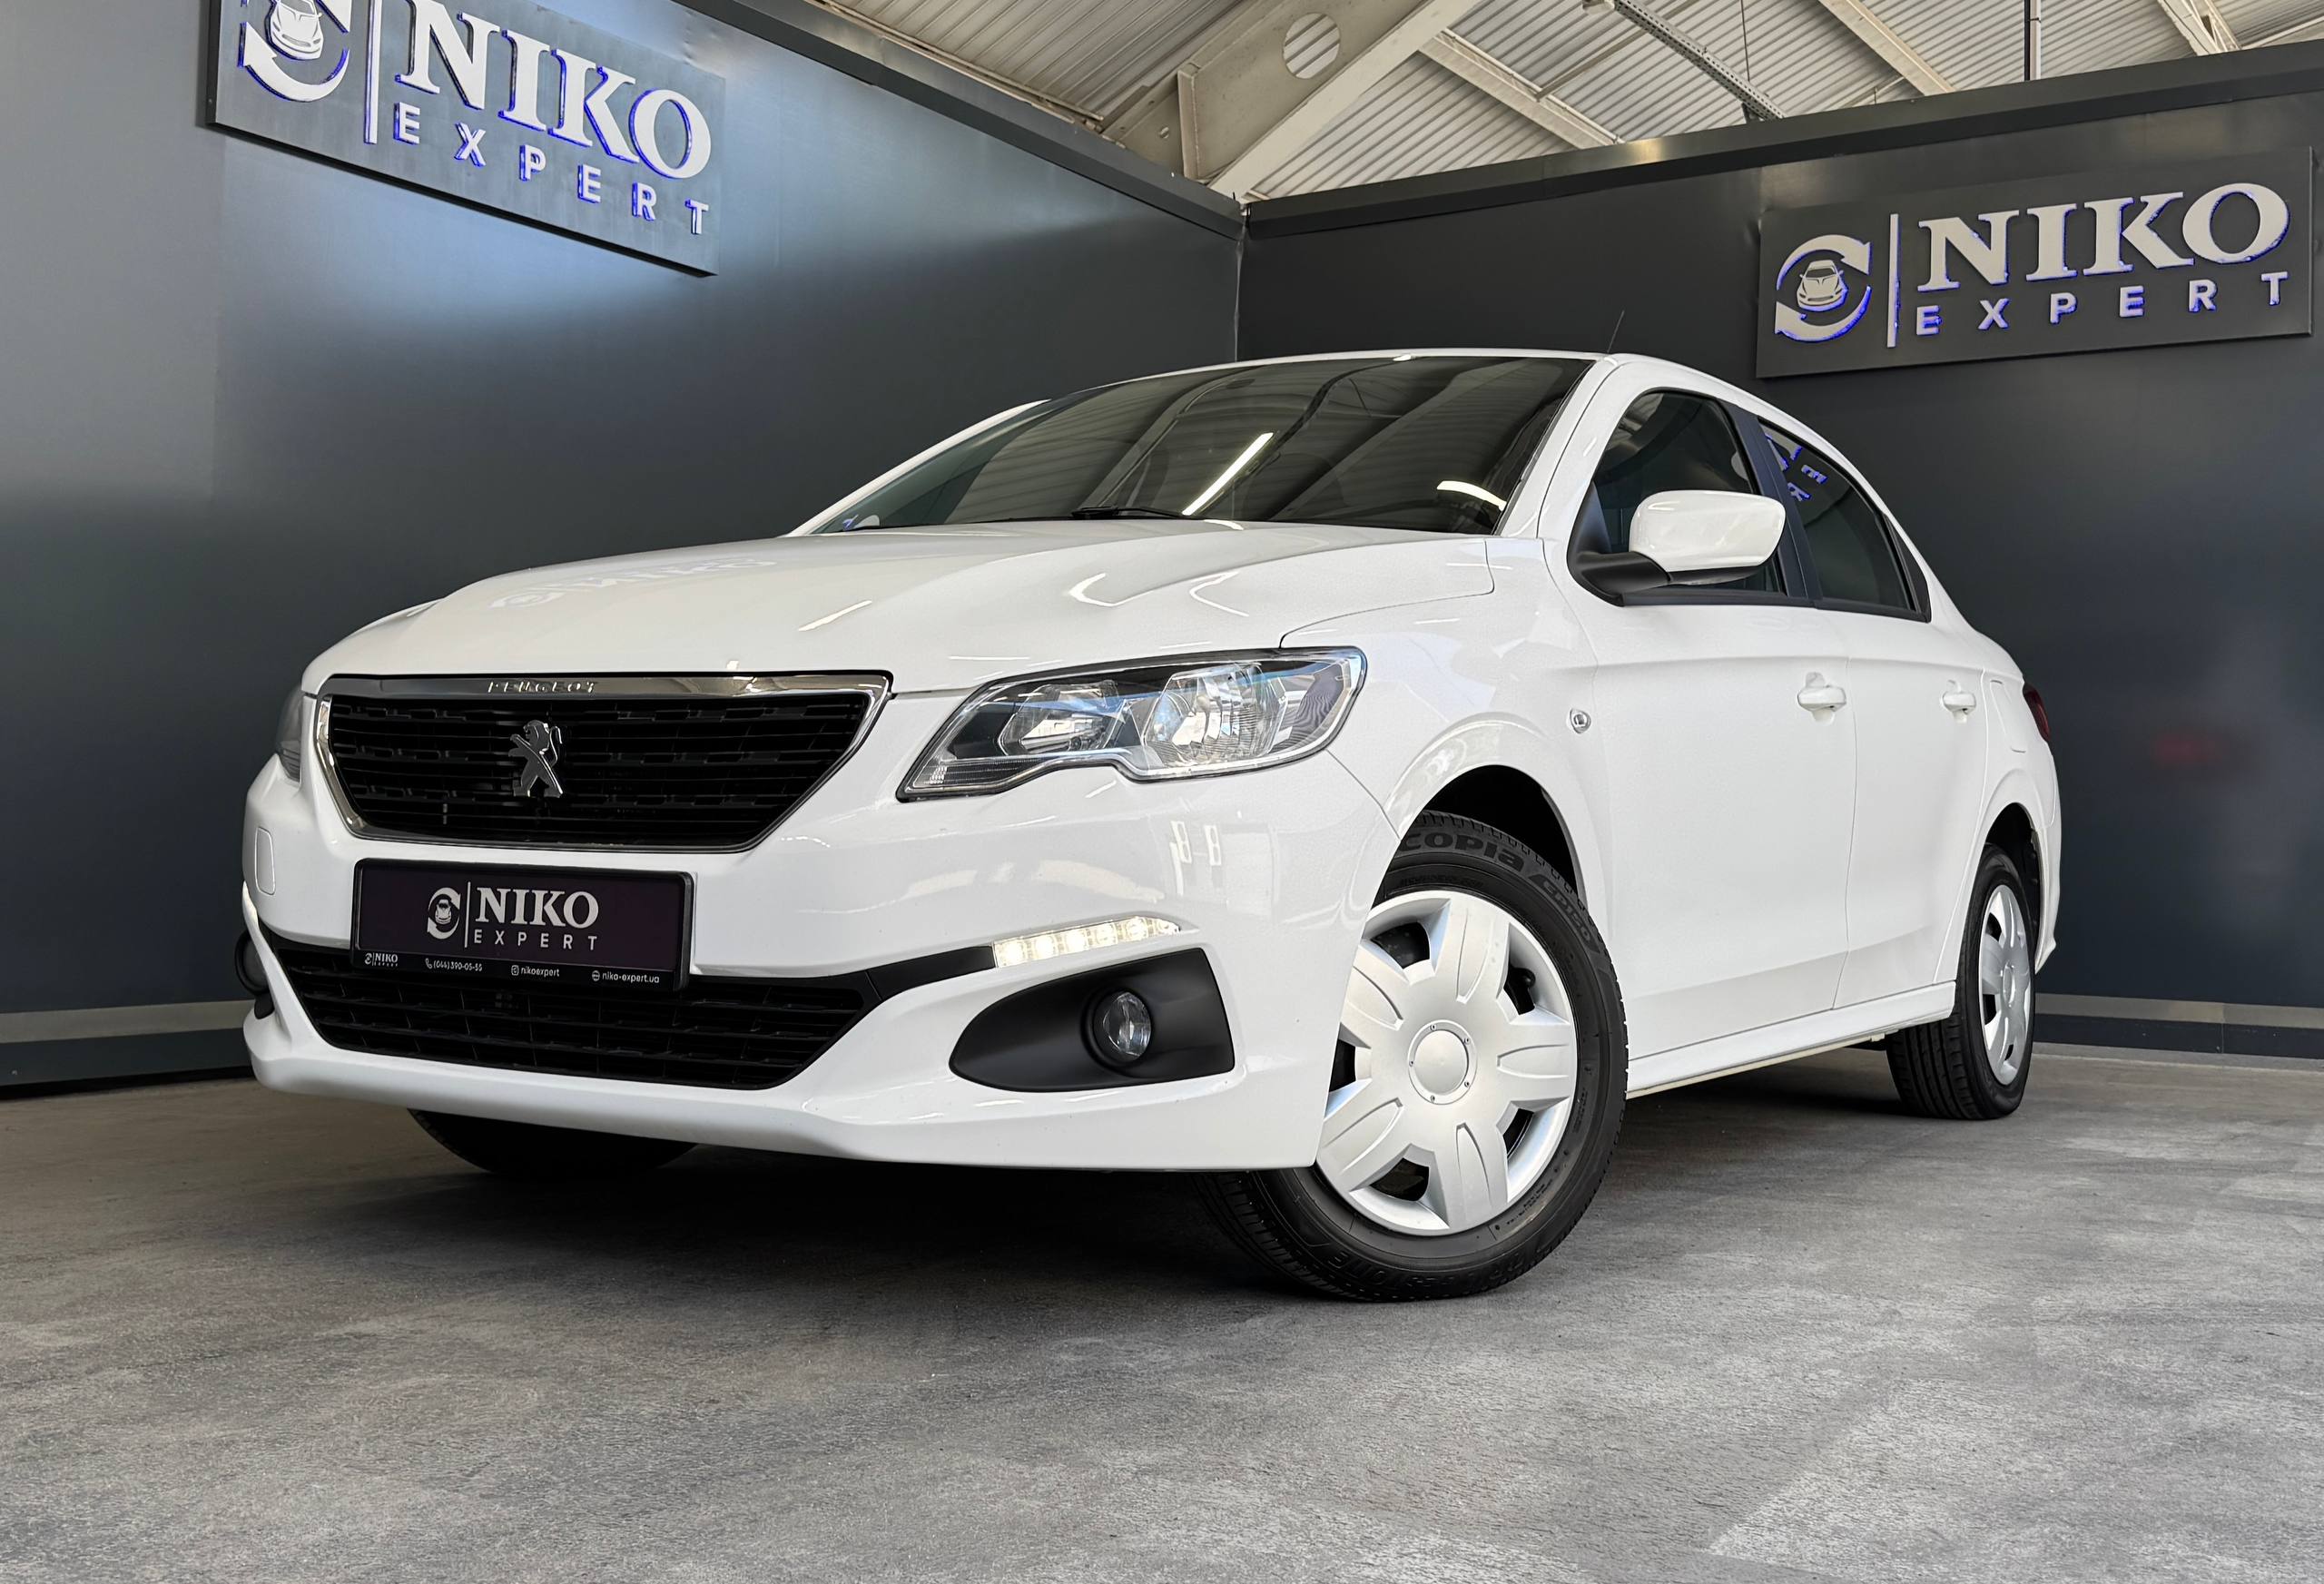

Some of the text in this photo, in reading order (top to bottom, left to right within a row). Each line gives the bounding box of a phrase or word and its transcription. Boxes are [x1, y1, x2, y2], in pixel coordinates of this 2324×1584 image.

[394, 0, 712, 179] NIKO
[394, 102, 709, 235] EXPERT
[1917, 182, 2290, 293] NIKO
[1915, 271, 2288, 336] EXPERT
[475, 887, 600, 930] NIKO
[375, 952, 399, 963] NIKO
[473, 929, 598, 951] EXPERT
[520, 966, 560, 978] nikoexpert
